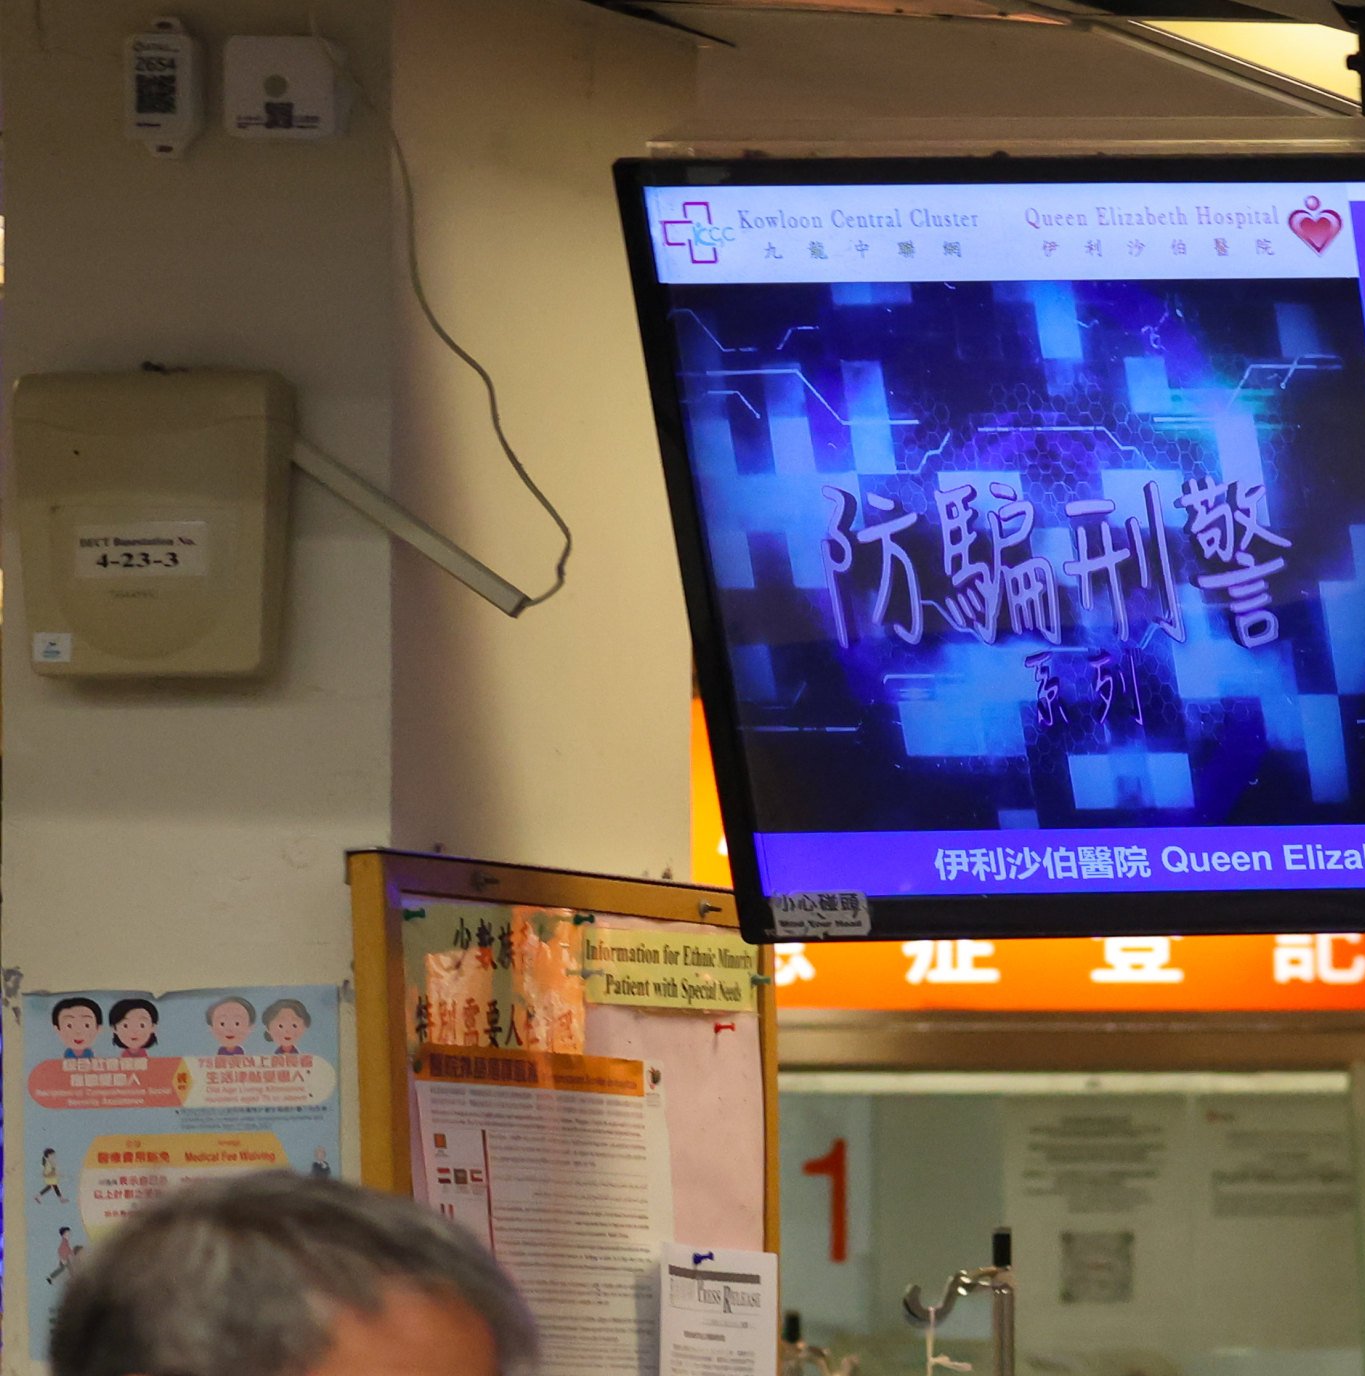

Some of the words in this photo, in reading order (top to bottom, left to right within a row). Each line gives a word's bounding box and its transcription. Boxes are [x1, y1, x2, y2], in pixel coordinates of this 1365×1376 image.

[738, 209, 823, 229] Kowloon
[831, 208, 901, 228] Central
[910, 207, 978, 228] Cluster
[1024, 206, 1087, 229] Queen
[1095, 206, 1188, 227] Elizabeth
[1196, 206, 1279, 229] Hospital
[764, 239, 962, 260] 九龍中聯網
[96, 552, 179, 568] 4-23-3
[820, 479, 1292, 649] 防騙刑警
[1025, 646, 1143, 727] 系列
[934, 845, 1151, 882] 伊利沙伯醫院
[1161, 844, 1273, 875] Queen
[586, 938, 660, 966] Information
[663, 944, 681, 966] for
[683, 945, 716, 968] Ethnic
[718, 947, 753, 970] Minority
[605, 973, 650, 997] Patient
[653, 976, 679, 999] with
[681, 978, 716, 1005] Special
[184, 1151, 219, 1163] Medical
[802, 1136, 849, 1264] 1
